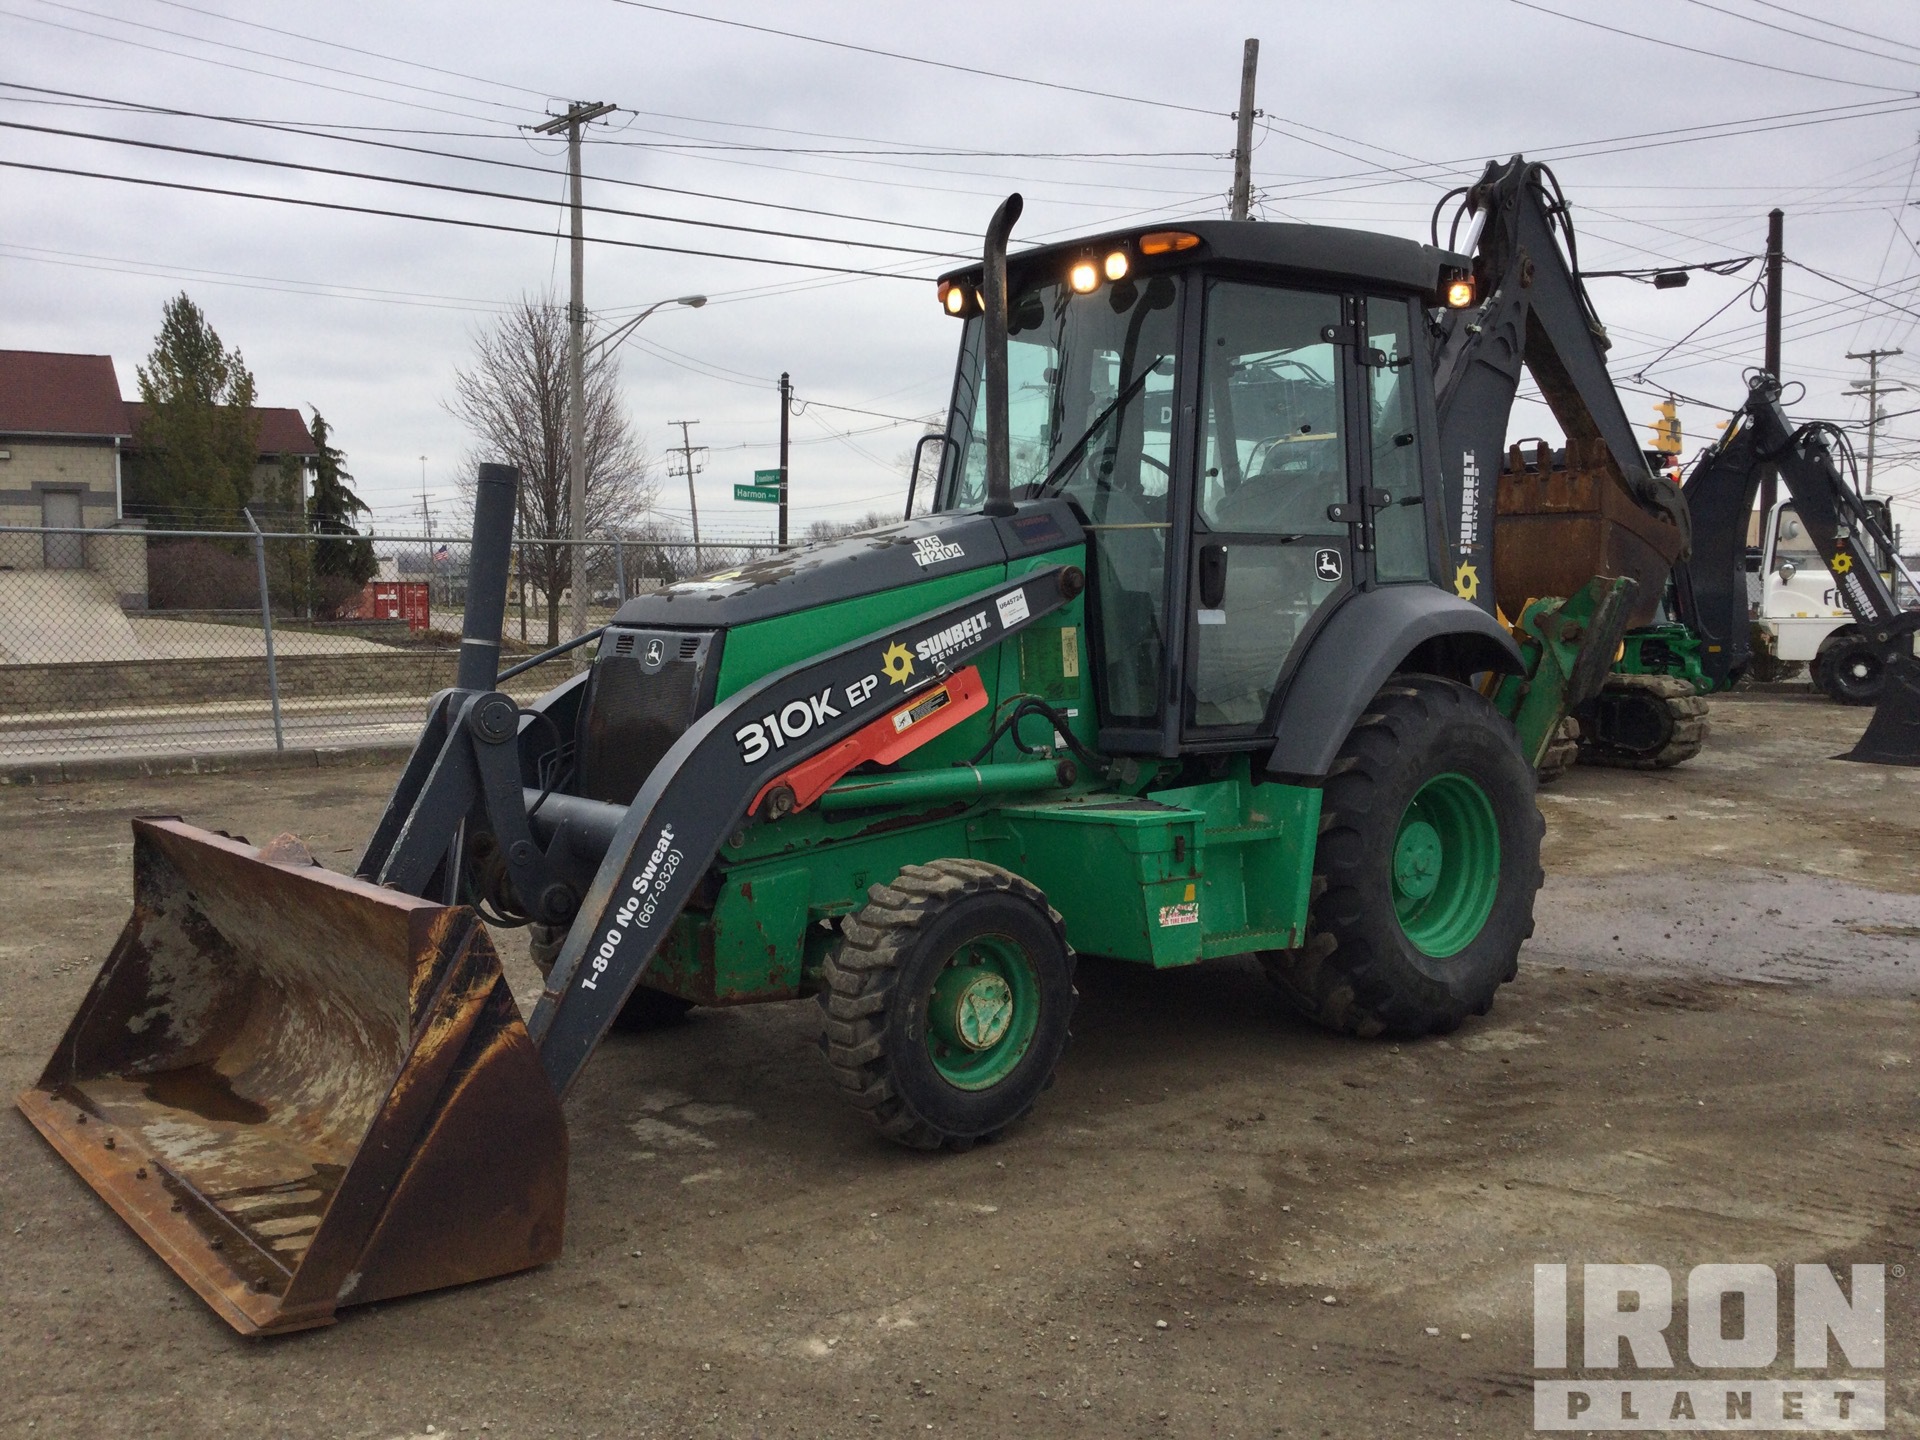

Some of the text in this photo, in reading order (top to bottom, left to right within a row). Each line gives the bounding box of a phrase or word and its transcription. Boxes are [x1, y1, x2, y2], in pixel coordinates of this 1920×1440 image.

[737, 488, 767, 499] Harmon
[1460, 451, 1475, 555] SUNBELT
[1472, 467, 1480, 542] RENTALS
[914, 544, 963, 565] 712104
[916, 536, 942, 550] 145
[999, 594, 1023, 609] U645724
[915, 610, 988, 661] SUNBELT
[930, 633, 982, 665] RENTALS
[735, 687, 842, 763] 310K
[845, 674, 878, 708] EP
[581, 829, 675, 991] 1-800 No Sweat
[635, 849, 684, 929] (667-9328)
